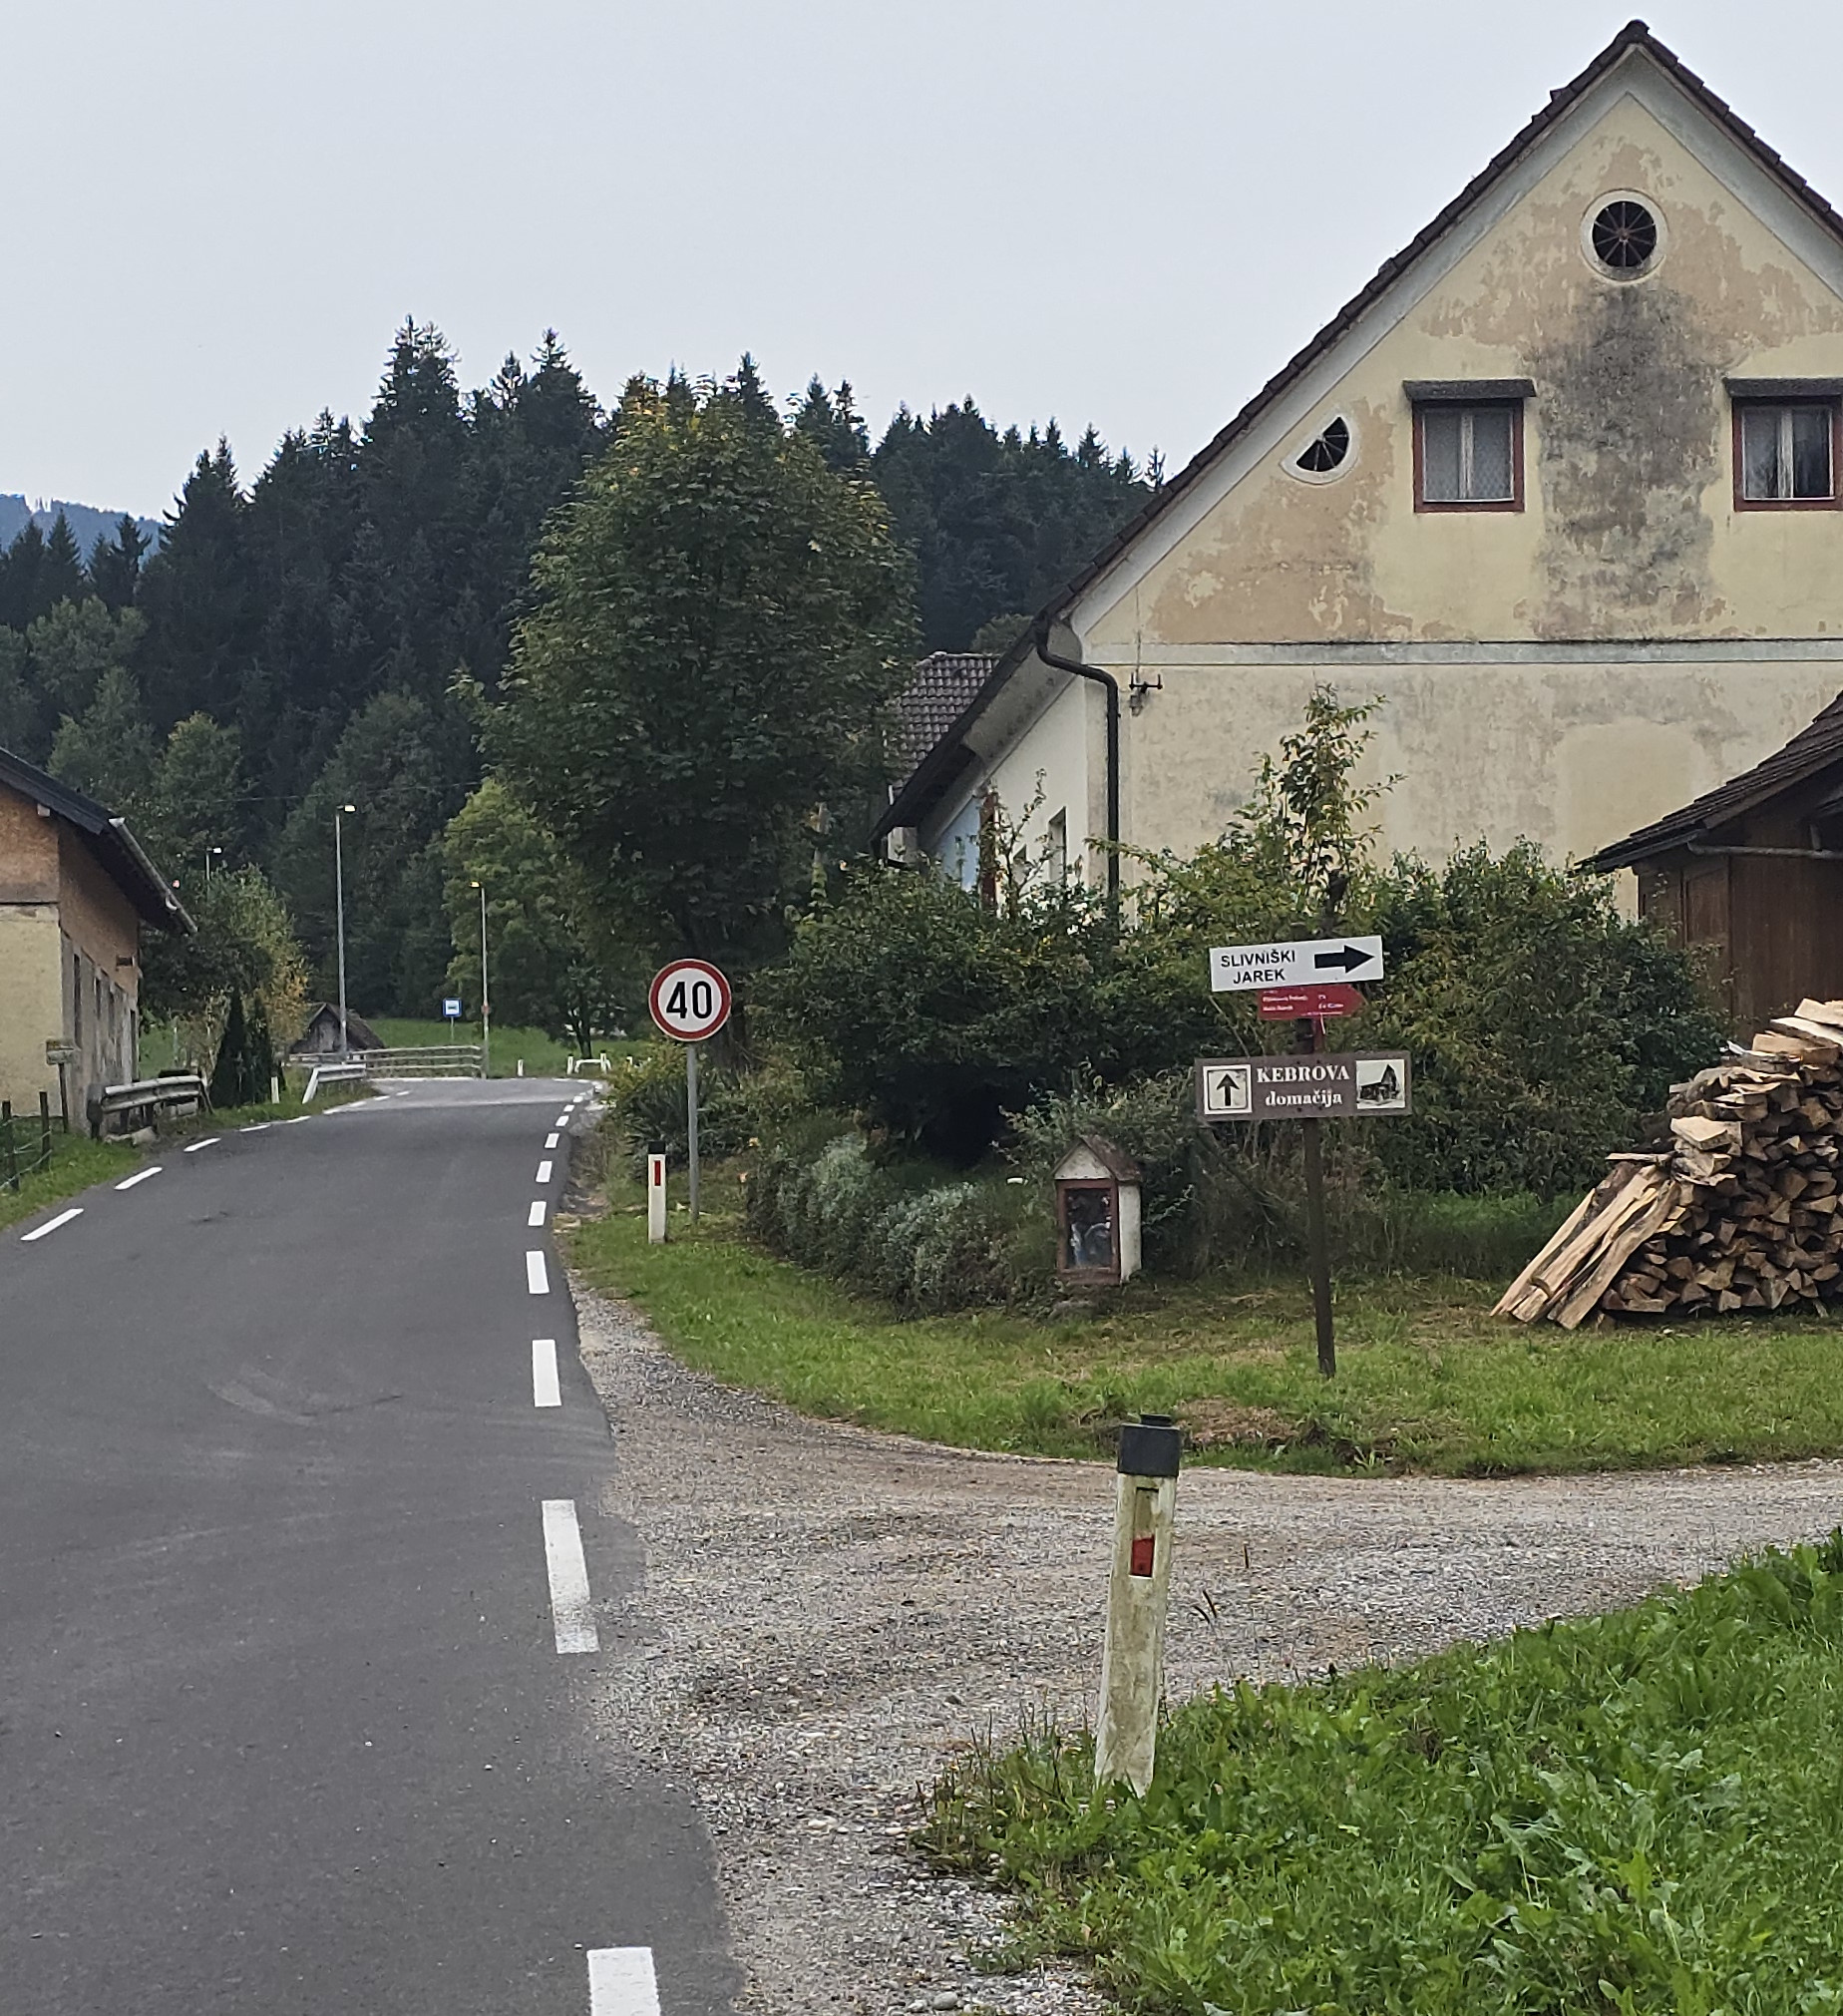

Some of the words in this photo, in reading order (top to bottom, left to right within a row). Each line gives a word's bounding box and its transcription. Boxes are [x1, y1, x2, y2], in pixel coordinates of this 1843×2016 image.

[1221, 949, 1295, 968] SLIVNIŠKI
[1233, 969, 1286, 985] JAREK
[666, 981, 712, 1019] 40
[1257, 1065, 1350, 1083] KEBROVA
[1265, 1089, 1342, 1107] domačija
